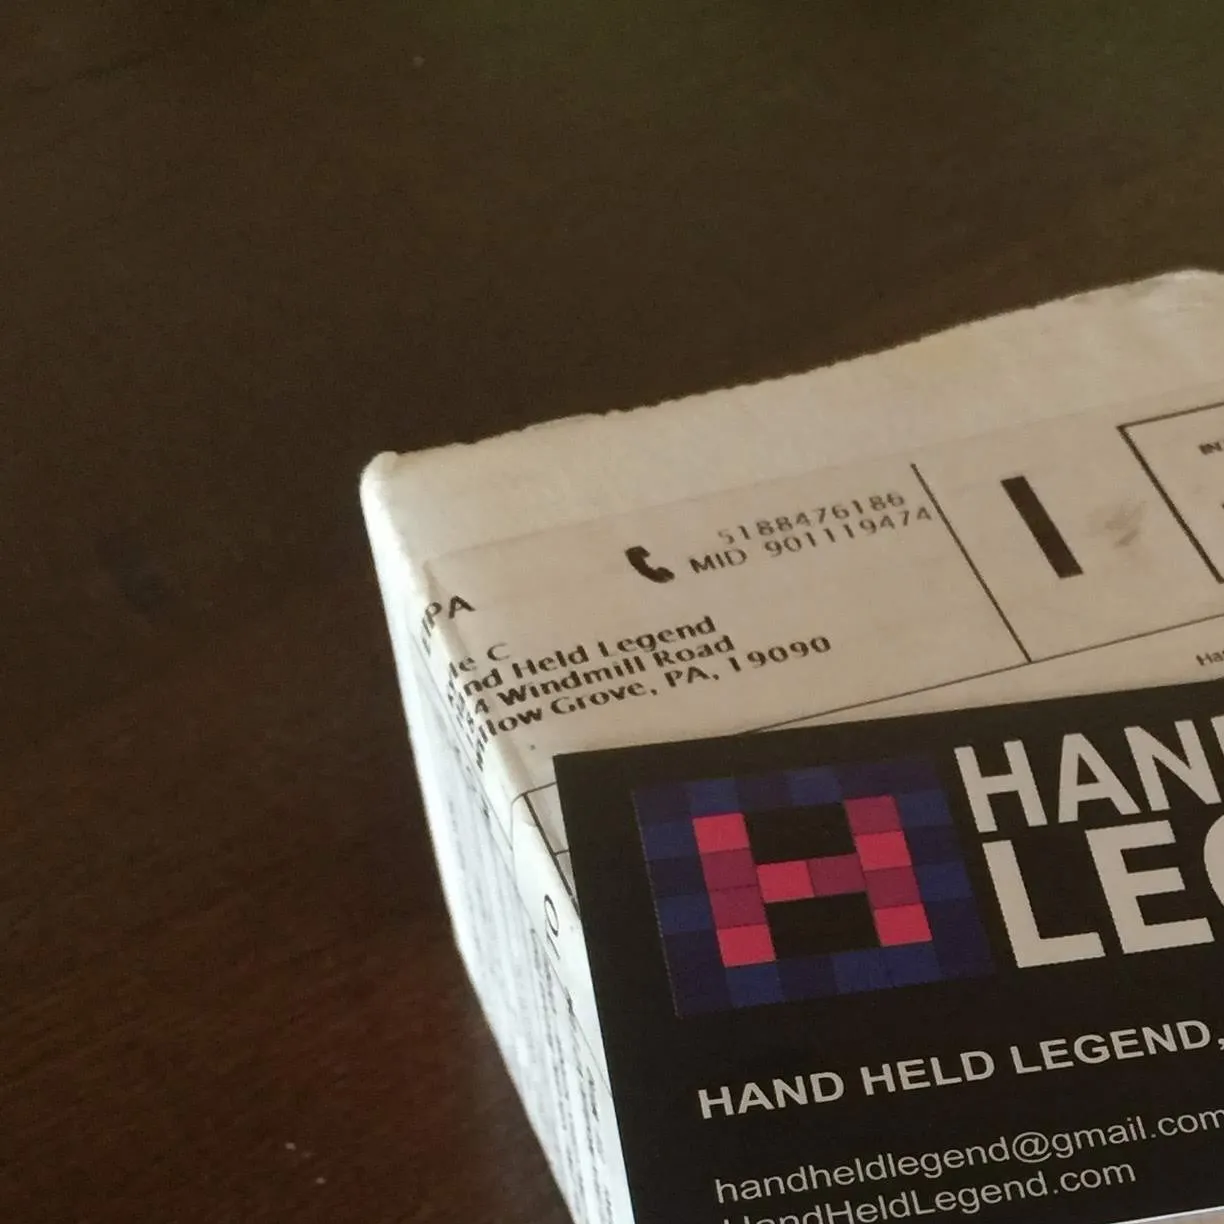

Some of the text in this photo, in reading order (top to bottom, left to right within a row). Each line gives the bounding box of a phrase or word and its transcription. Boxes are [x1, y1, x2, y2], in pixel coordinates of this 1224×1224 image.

[688, 547, 748, 575] MID
[496, 655, 647, 708] Windmill
[651, 634, 736, 668] Road
[511, 644, 589, 681] Held
[597, 614, 717, 659] Legend
[550, 681, 659, 716] Grove,
[663, 664, 720, 689] PA,
[727, 635, 832, 674] 19090
[697, 1071, 845, 1120] HAND
[859, 1049, 996, 1097] HELD
